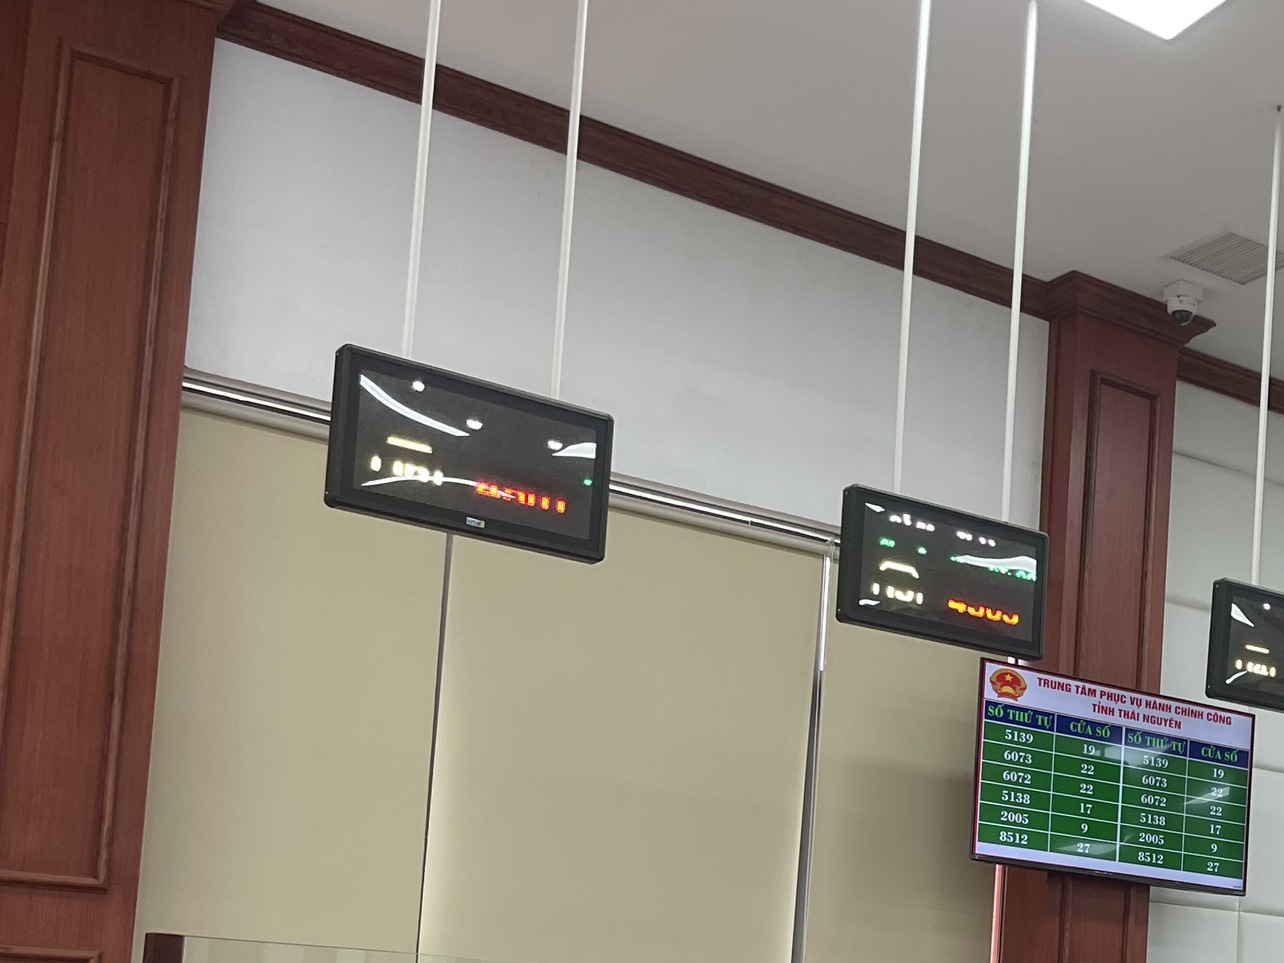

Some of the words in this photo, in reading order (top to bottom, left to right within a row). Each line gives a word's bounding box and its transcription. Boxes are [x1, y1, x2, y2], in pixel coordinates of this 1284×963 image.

[1037, 677, 1071, 692] TRUNG
[1075, 684, 1096, 698] TÂM
[1100, 690, 1126, 704] PHỤC
[1130, 696, 1142, 709] VỤ
[1145, 699, 1171, 713] HÀNH
[1175, 706, 1203, 719] CHÍNH
[1207, 712, 1232, 725] CÔNG
[988, 704, 1004, 717] SỐ
[1007, 709, 1033, 724] THỨ
[1036, 715, 1053, 729] TỰ
[1092, 702, 1115, 716] TỈNH
[1119, 708, 1139, 721] THÁI
[1143, 713, 1181, 729] NGUYÊN
[1005, 729, 1033, 743] 5139
[1082, 744, 1095, 755] 19
[1004, 750, 1032, 764] 6073
[1143, 755, 1168, 768] 5139
[1080, 763, 1094, 775] 22
[1213, 768, 1224, 778] 19
[1003, 770, 1031, 784] 6072
[1142, 775, 1167, 788] 6073
[1080, 783, 1093, 795] 22
[1211, 787, 1223, 797] 22
[1001, 790, 1030, 804] 5138
[1141, 794, 1167, 807] 6072
[1080, 803, 1092, 814] 17
[1210, 806, 1222, 816] 22
[1000, 811, 1029, 824] 2005
[1140, 813, 1166, 826] 5138
[1081, 823, 1088, 833] 9
[1210, 825, 1221, 835] 17
[999, 831, 1028, 844] 8512
[1139, 832, 1164, 845] 2005
[1077, 843, 1090, 854] 27
[1211, 843, 1217, 853] 9
[1138, 852, 1164, 864] 8512
[1207, 862, 1219, 872] 27
